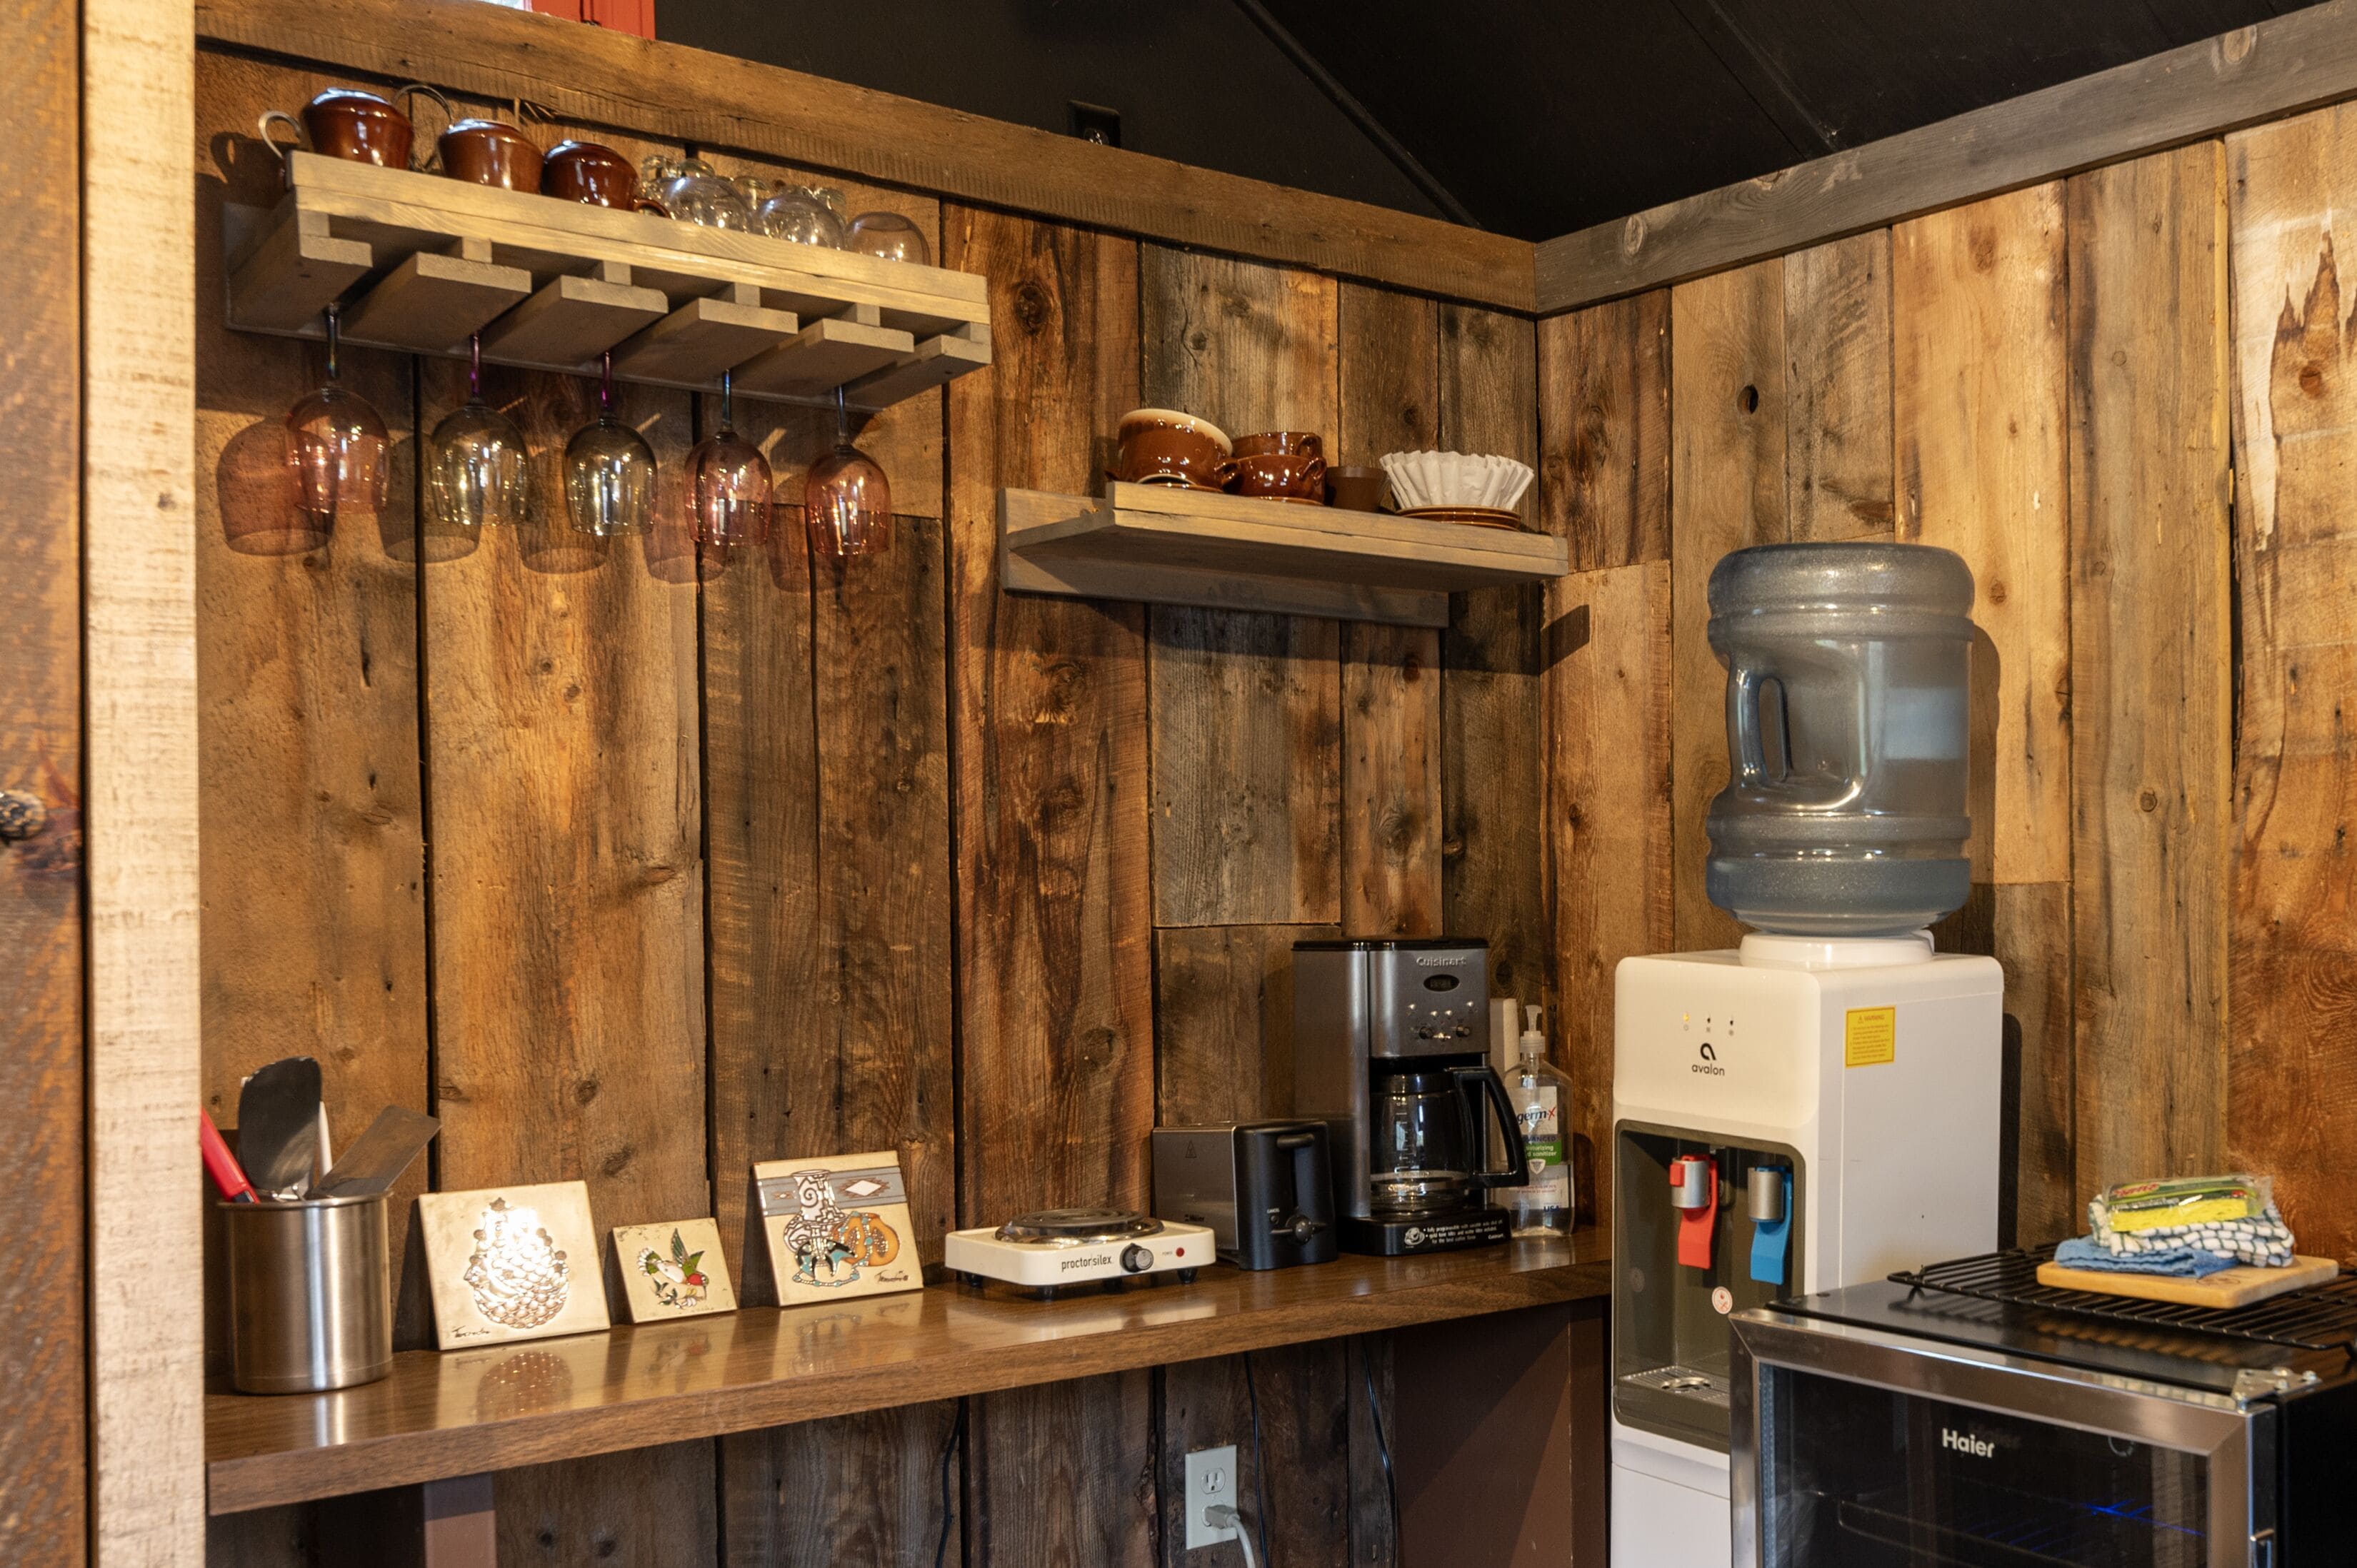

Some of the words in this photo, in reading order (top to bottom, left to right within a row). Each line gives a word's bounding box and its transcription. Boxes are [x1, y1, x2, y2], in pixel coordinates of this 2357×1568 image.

[1416, 956, 1467, 968] Cuisinart
[1691, 1063, 1726, 1076] avalon
[1942, 1427, 1995, 1458] Haier
